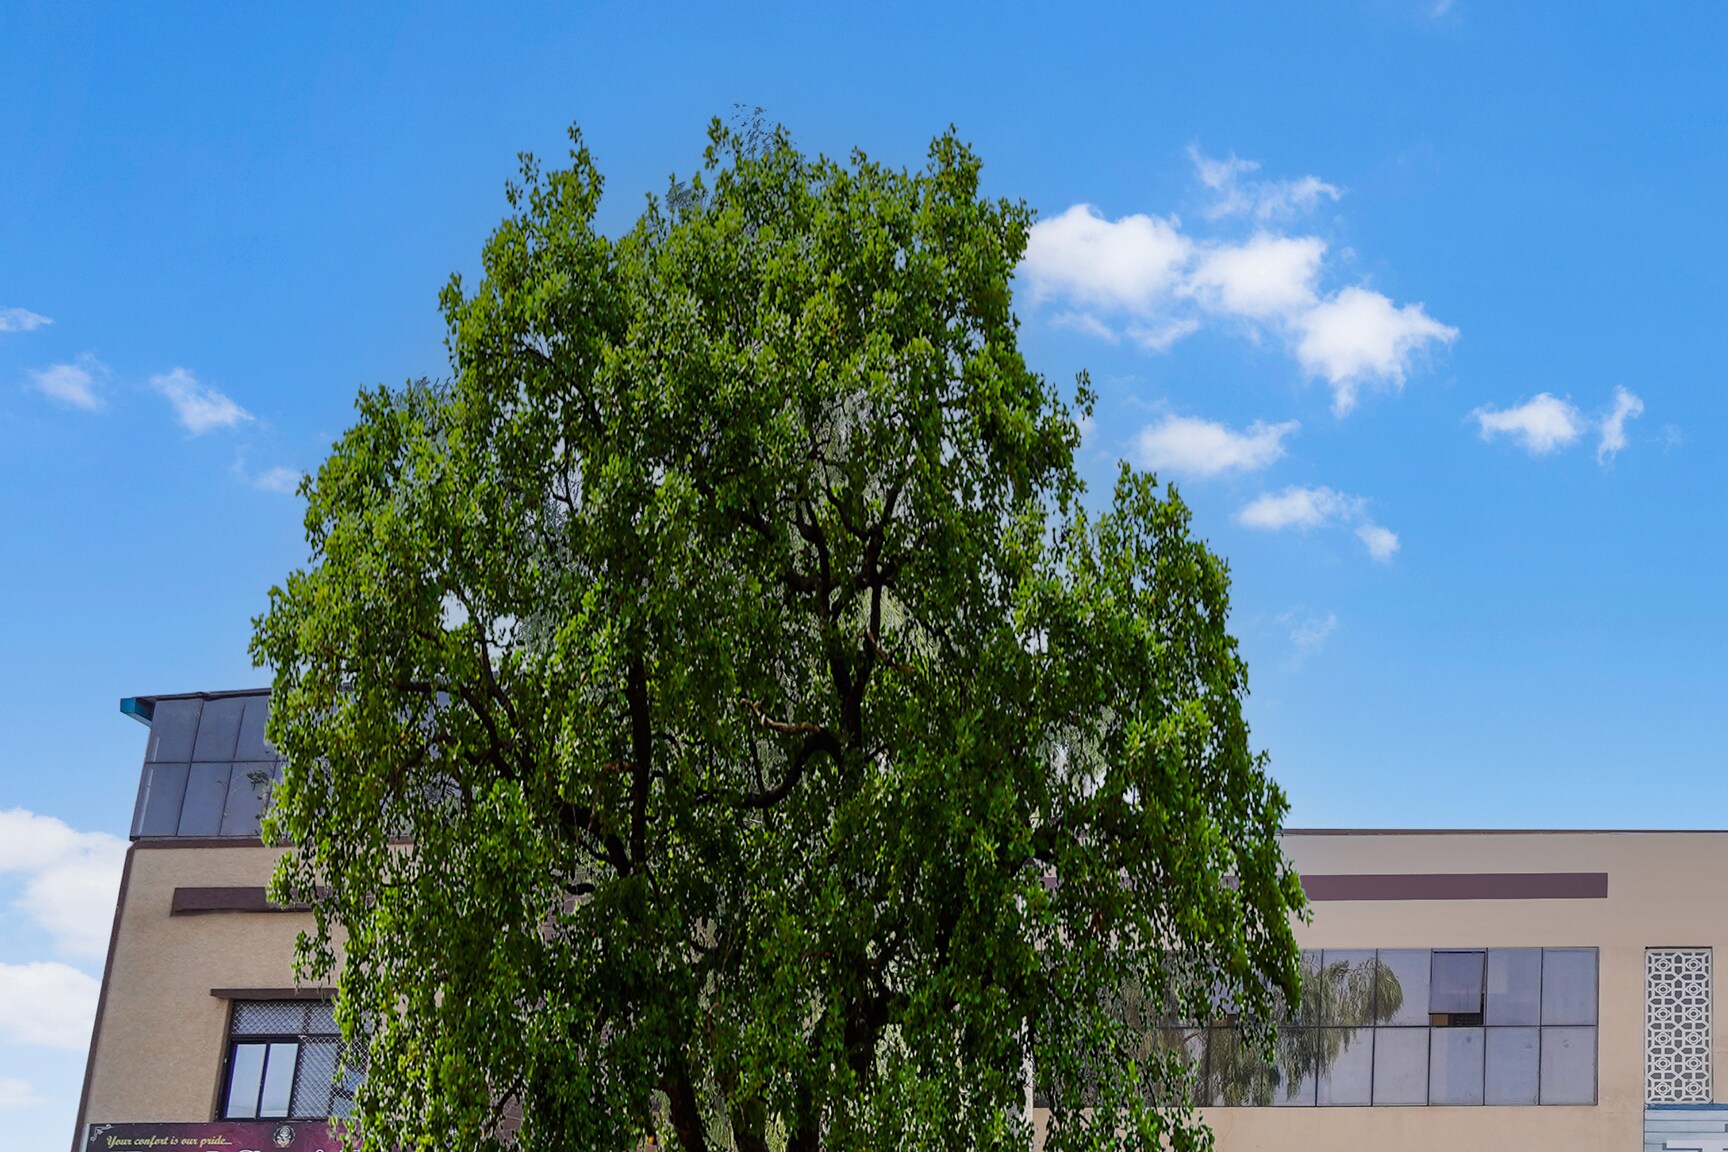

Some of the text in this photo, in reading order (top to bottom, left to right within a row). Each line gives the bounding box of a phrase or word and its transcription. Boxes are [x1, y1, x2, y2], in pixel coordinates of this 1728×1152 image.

[107, 1135, 132, 1146] Your
[170, 1137, 179, 1146] is
[181, 1138, 198, 1146] our
